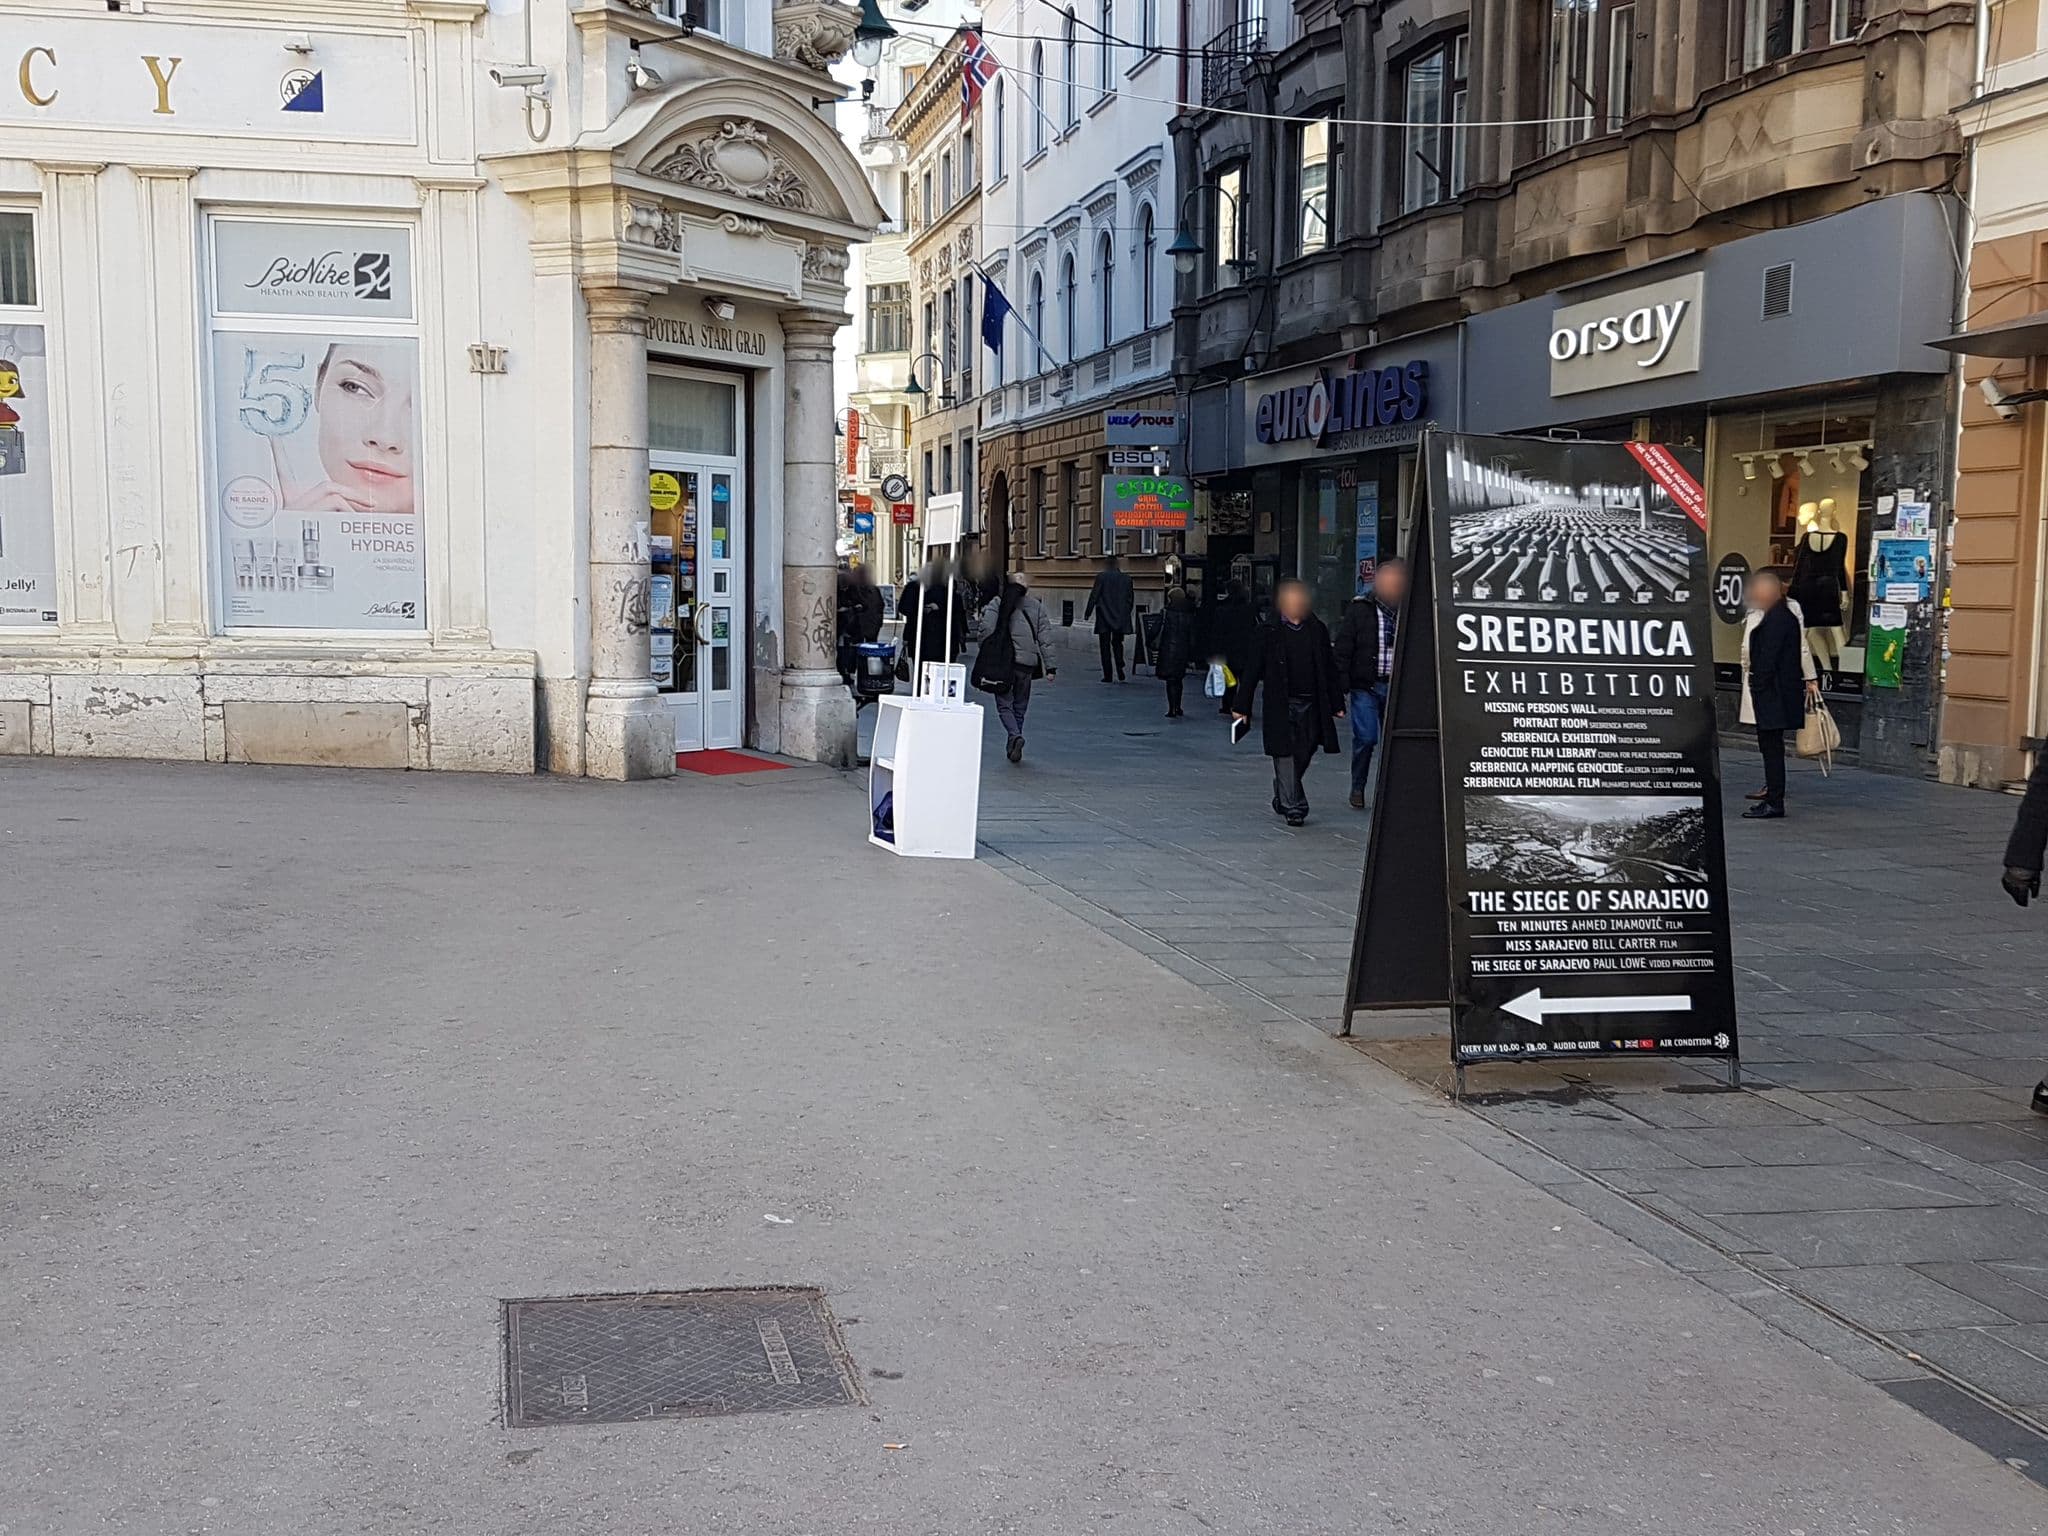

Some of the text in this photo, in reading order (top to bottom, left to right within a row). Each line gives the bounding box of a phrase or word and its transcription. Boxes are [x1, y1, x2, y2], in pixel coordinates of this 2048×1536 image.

[244, 251, 351, 288] BioNike
[260, 288, 350, 298] HEALTH AND BEAUTY
[701, 324, 733, 352] STARI
[736, 330, 766, 356] GRAD
[1549, 300, 1689, 367] orsay
[1142, 416, 1175, 426] TOURS
[1367, 422, 1423, 446] HERCEGOVIN
[1635, 443, 1645, 455] THE
[1655, 466, 1673, 484] AWARD
[1671, 482, 1694, 506] FINALIST
[1115, 477, 1184, 499] SEDEF
[1694, 494, 1703, 502] OF
[341, 521, 415, 536] DEFENCE
[351, 539, 415, 553] HYDRA5
[5, 578, 36, 593] Jelly!
[1456, 613, 1693, 657] SREBRENICA
[1464, 670, 1691, 697] EXHIBITION
[1484, 702, 1525, 713] MISSING
[1527, 703, 1569, 714] PERSONS
[1571, 704, 1597, 714] WALL
[1513, 717, 1559, 728] PORTRAIT
[1561, 718, 1588, 728] ROOM
[1501, 732, 1560, 743] SREBRENICA
[1562, 733, 1617, 744] EXHIBITION
[1481, 747, 1529, 758] GENOCIDE
[1531, 747, 1554, 758] FILM
[1556, 748, 1597, 759] LIBRARY
[1470, 761, 1529, 773] SREBRENICA
[1531, 762, 1575, 773] MAPPING
[1577, 763, 1624, 774] GENOCIDE
[1463, 776, 1523, 788] SREBRENICA
[1525, 777, 1576, 788] MEMORIAL
[1578, 778, 1600, 788] FILM
[1468, 889, 1709, 912] THE SIEGE OF SARAJEVO
[1497, 920, 1517, 931] TEN
[1521, 920, 1568, 931] MINUTES
[1571, 919, 1607, 931] AHMED
[1665, 920, 1683, 930] FILM
[1506, 938, 1678, 951] MISS SARAJEVO BILL CARTER FILM
[1472, 957, 1714, 972] THE SIEGE OF SARAJEVO PAUL LOWE VIDEO PROJECTION
[1461, 1044, 1481, 1053] EVERY
[1483, 1044, 1497, 1053] DAY
[1499, 1043, 1520, 1053] 10.00
[1553, 1042, 1576, 1050] AUDIO
[1578, 1041, 1600, 1049] GUIDE
[1660, 1039, 1672, 1047] AIR
[1674, 1039, 1712, 1047] CONDITION
